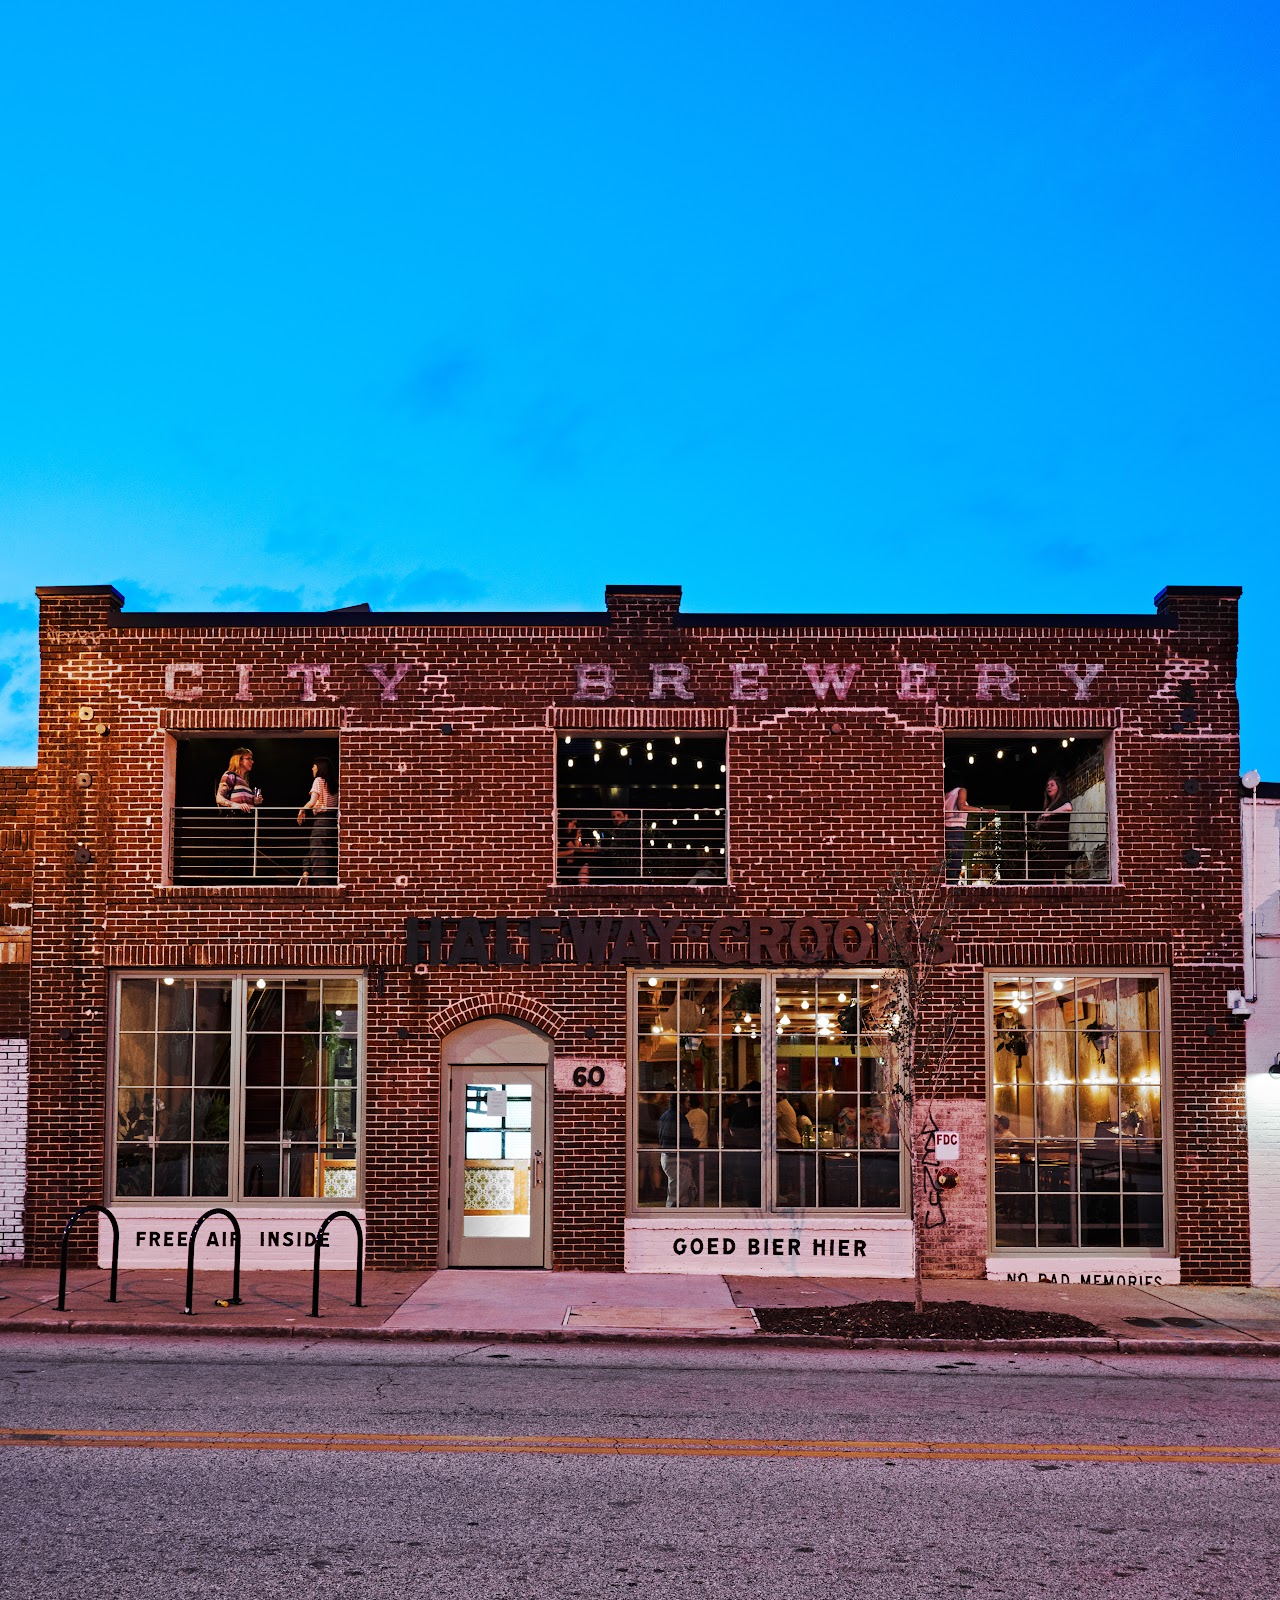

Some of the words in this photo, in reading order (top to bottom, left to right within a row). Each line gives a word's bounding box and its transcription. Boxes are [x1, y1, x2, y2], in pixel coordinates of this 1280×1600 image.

[165, 662, 412, 700] CITY
[573, 662, 1104, 700] BREWERY
[405, 916, 683, 965] HALFWAY
[573, 1066, 605, 1087] 60
[936, 1134, 958, 1145] FDC
[136, 1231, 188, 1247] FREE
[260, 1231, 330, 1247] INSIDE
[673, 1238, 736, 1255] GOED
[748, 1238, 801, 1256] BIER
[813, 1239, 867, 1257] HIER
[1007, 1273, 1028, 1282] NO
[1080, 1274, 1162, 1286] MEMORIES
